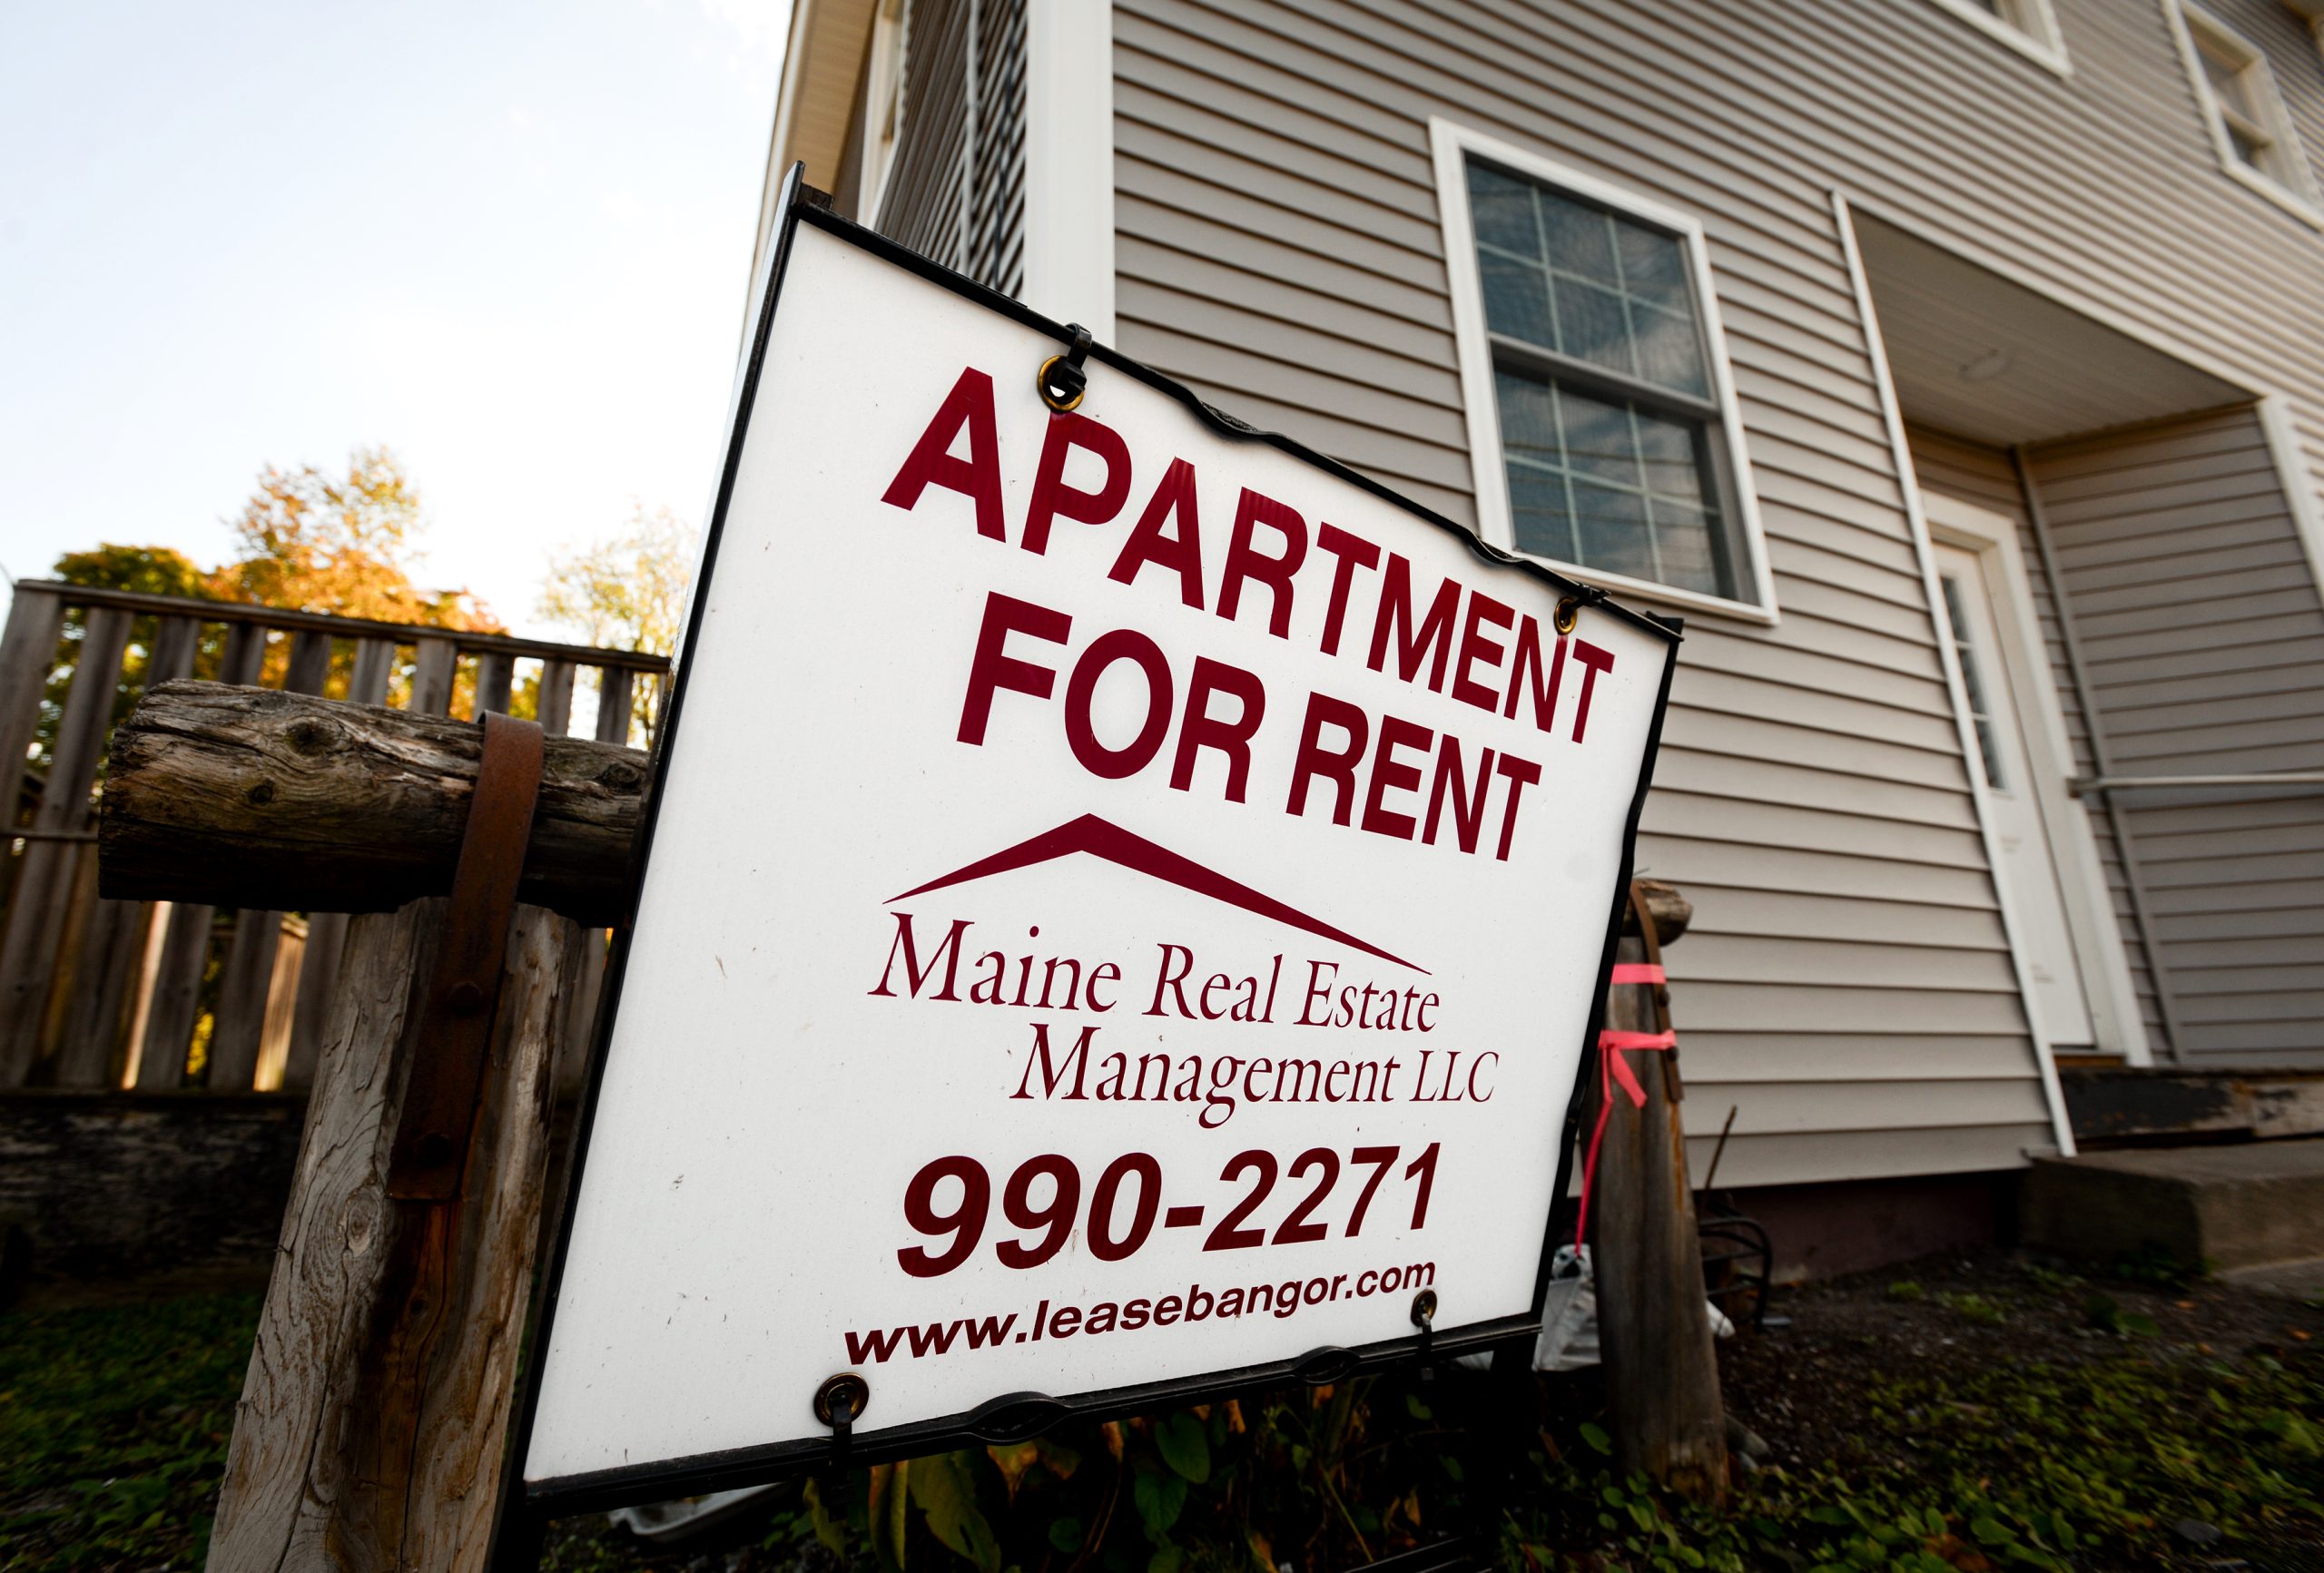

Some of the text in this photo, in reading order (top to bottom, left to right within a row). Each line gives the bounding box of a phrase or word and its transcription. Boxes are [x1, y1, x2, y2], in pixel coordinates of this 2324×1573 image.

[881, 367, 1615, 744] APARTMENT
[956, 591, 1542, 862] FOR RENT
[867, 912, 1441, 1033] Maine Real Estate
[1009, 1023, 1501, 1129] Management LLC
[897, 1142, 1442, 1279] 990-2271
[844, 1262, 1437, 1366] www.leasebangor.com
